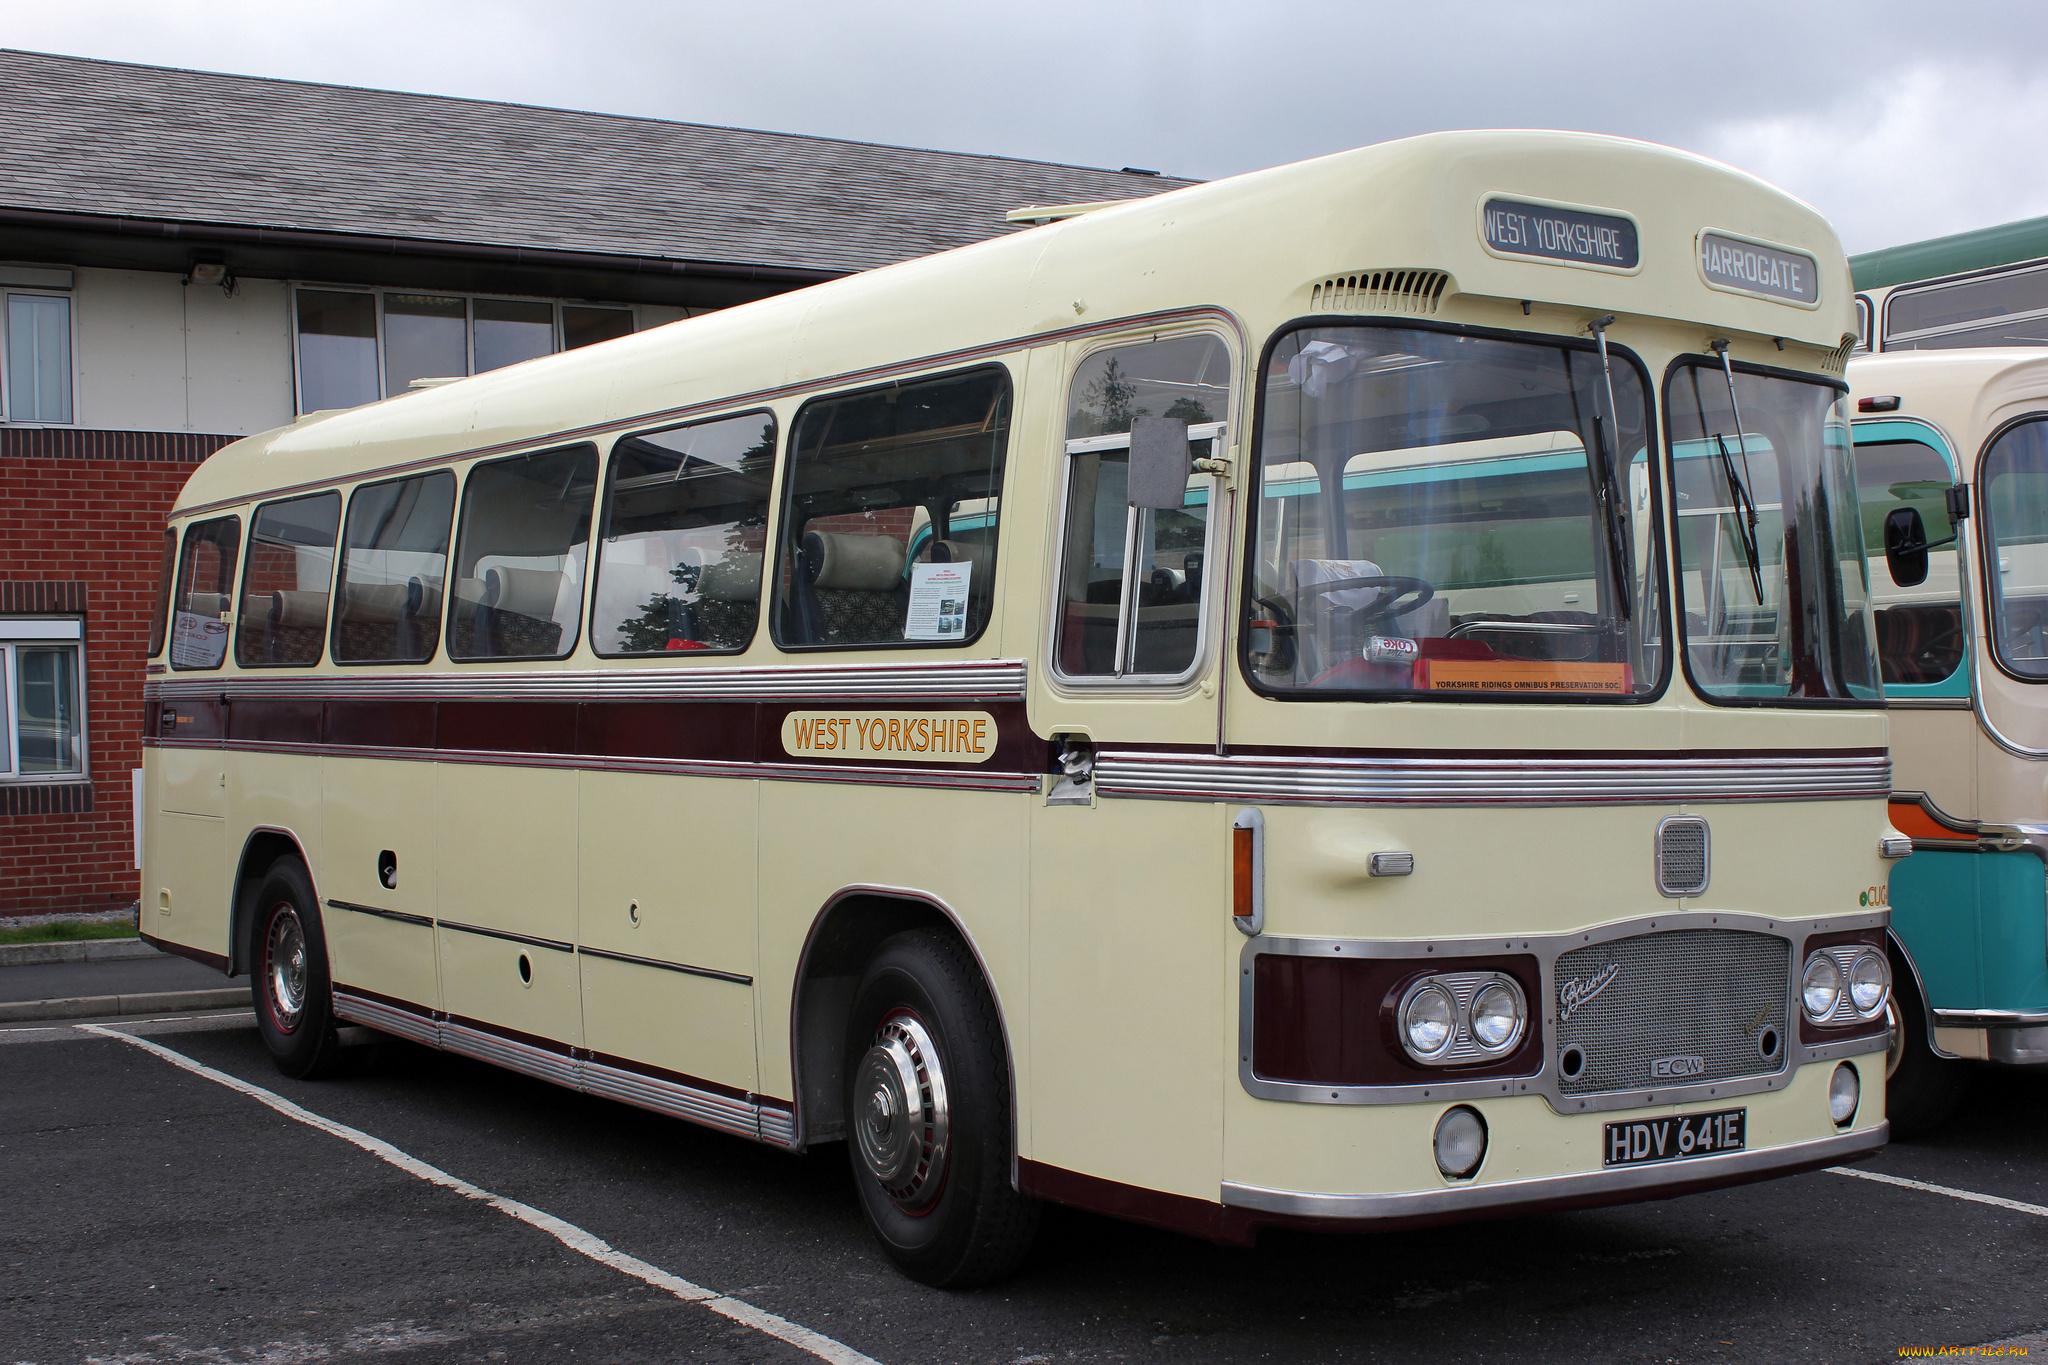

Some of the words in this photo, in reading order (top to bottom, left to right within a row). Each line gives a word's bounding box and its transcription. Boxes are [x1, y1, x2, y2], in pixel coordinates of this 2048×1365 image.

[1483, 208, 1527, 247] WEST
[1533, 217, 1623, 261] YORKSHIRE
[1383, 639, 1414, 654] Coke
[1435, 681, 1480, 689] YORKSHIRE
[1481, 681, 1512, 689] RIDINGS
[1514, 681, 1548, 689] OMNIBUS
[1604, 682, 1621, 690] SOC.
[794, 718, 851, 750] WEST
[855, 718, 987, 753] YORKSHIRE
[1656, 1058, 1701, 1076] ECW
[1611, 1121, 1669, 1162] HDV
[1678, 1113, 1740, 1153] 641E
